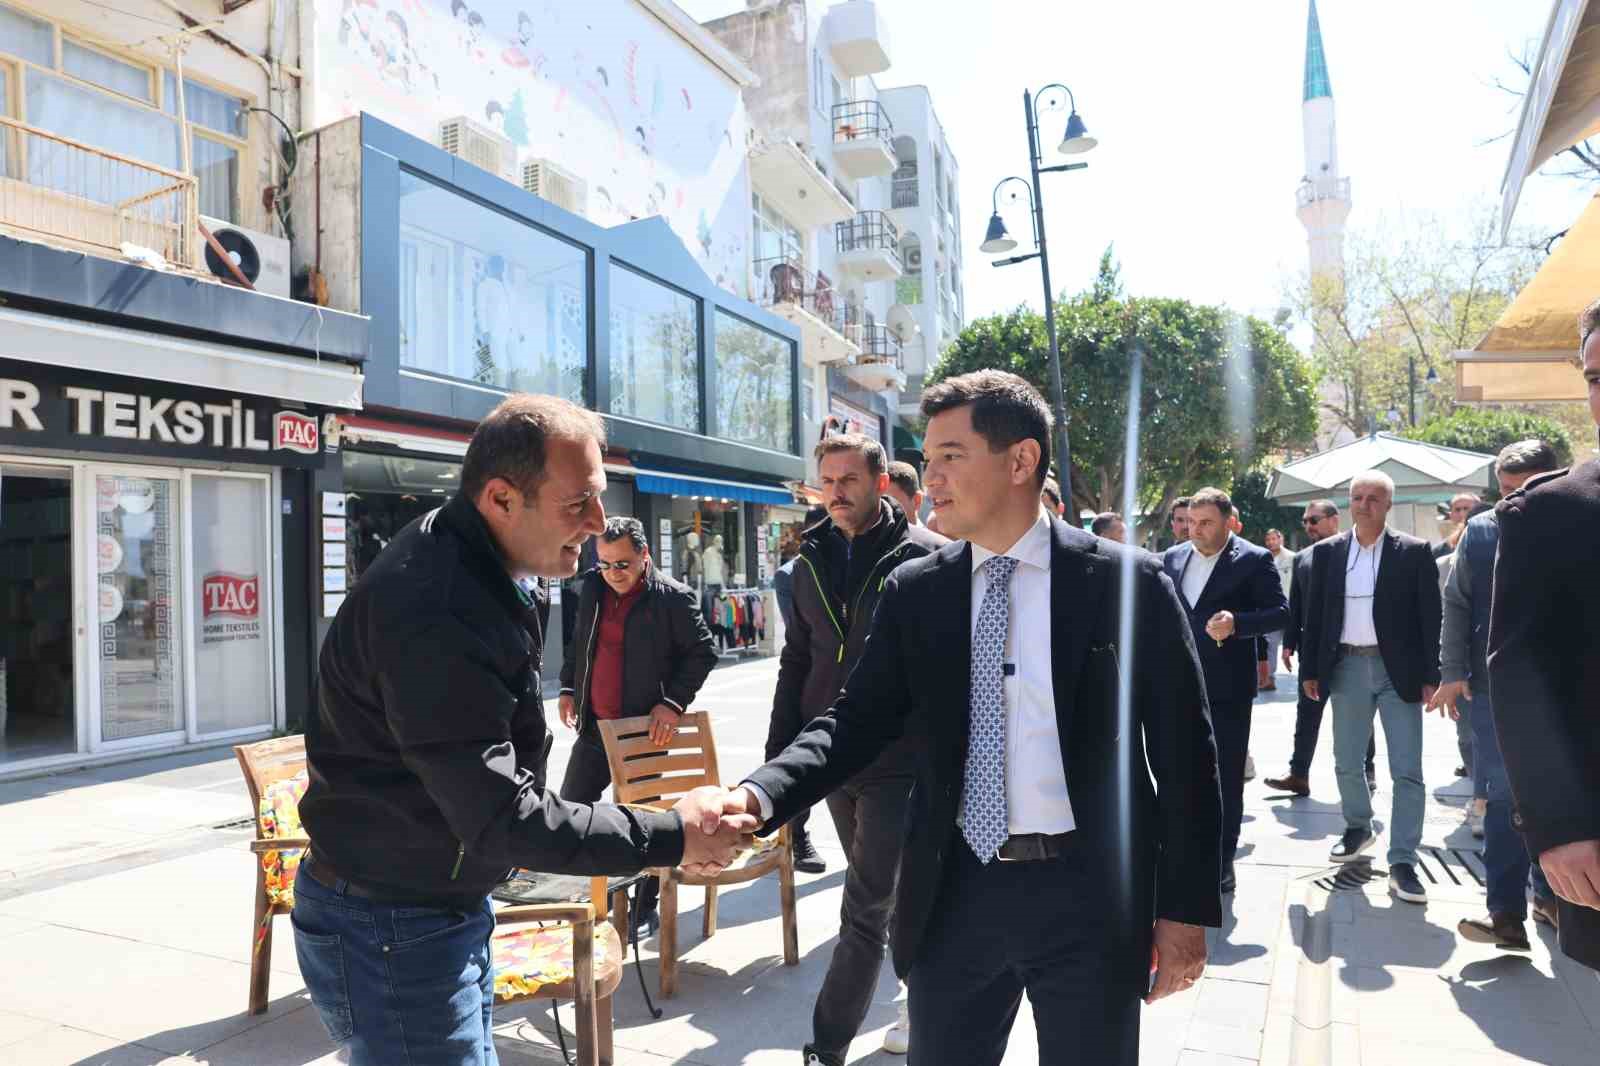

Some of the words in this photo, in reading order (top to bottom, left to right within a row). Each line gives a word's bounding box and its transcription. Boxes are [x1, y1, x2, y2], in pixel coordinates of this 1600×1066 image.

[65, 385, 270, 451] TEKSTİL
[279, 420, 316, 448] TAÇ
[206, 581, 257, 614] TAÇ
[203, 623, 224, 634] HOME
